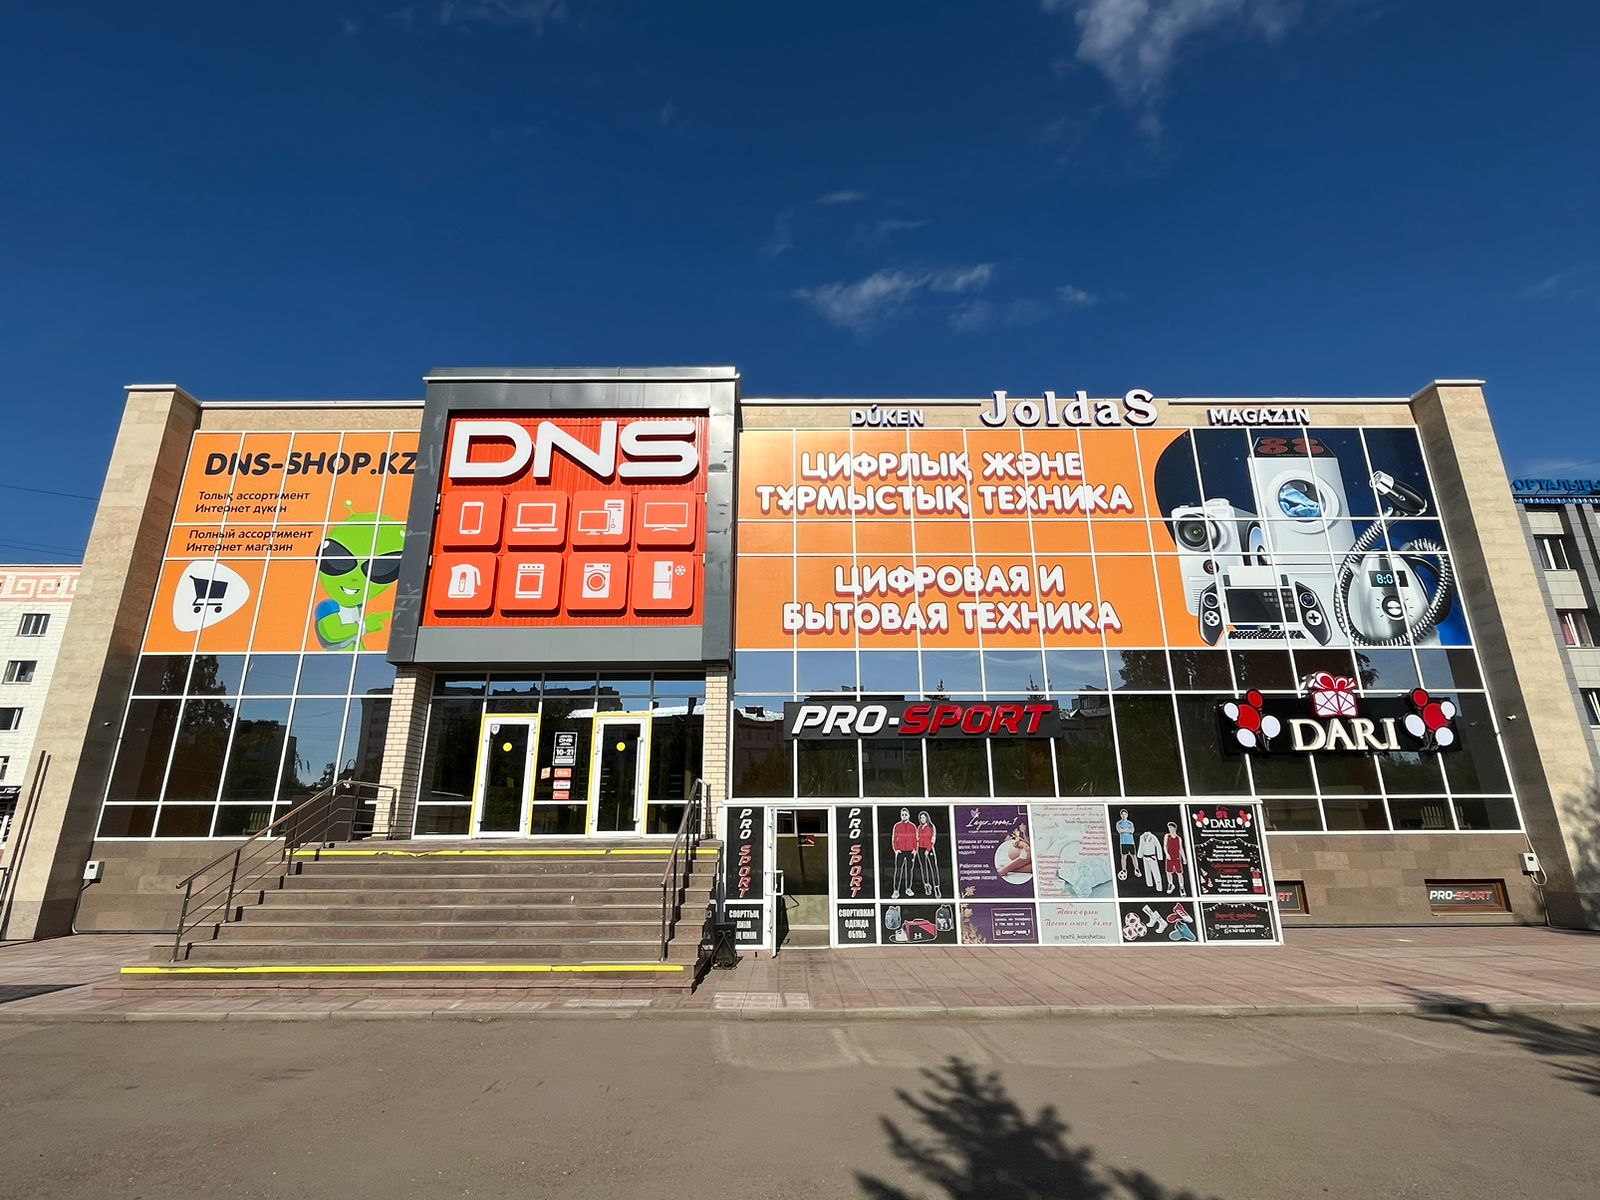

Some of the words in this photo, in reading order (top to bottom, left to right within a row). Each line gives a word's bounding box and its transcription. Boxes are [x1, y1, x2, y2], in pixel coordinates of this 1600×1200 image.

[850, 404, 925, 426] DÚKEN
[980, 388, 1158, 427] JoldaS
[1207, 408, 1311, 426] MAGAZIN
[204, 451, 417, 476] DNS-SHOP.KZ
[448, 420, 699, 481] DNS
[801, 451, 973, 480] ЦИФРЛЫҚ
[982, 451, 1083, 478] ЖӘНЕ
[195, 503, 250, 514] Интернет
[253, 504, 287, 514] дүкен
[199, 490, 233, 501] Толық
[236, 491, 310, 501] ассортимент
[756, 485, 970, 514] ТҰРМЫСТЫҚ
[977, 484, 1134, 512] ТЕХНИКА
[186, 542, 242, 553] Интернет
[245, 543, 293, 552] магазин
[189, 529, 235, 540] Полный
[238, 530, 313, 541] ассортимент
[834, 565, 1032, 596] ЦИФРОВАЯ
[1038, 565, 1065, 594] И
[782, 602, 949, 633] БЫТОВАЯ
[957, 601, 1122, 632] ТЕХНИКА
[791, 704, 1053, 735] PRO-SPORT
[1288, 717, 1401, 751] DARI
[740, 808, 752, 840] PRO
[848, 808, 861, 839] PRO
[1210, 818, 1236, 828] DARI
[738, 844, 752, 898] SPORT
[849, 844, 862, 898] SPORT
[1429, 890, 1493, 900] PRO-SPORT
